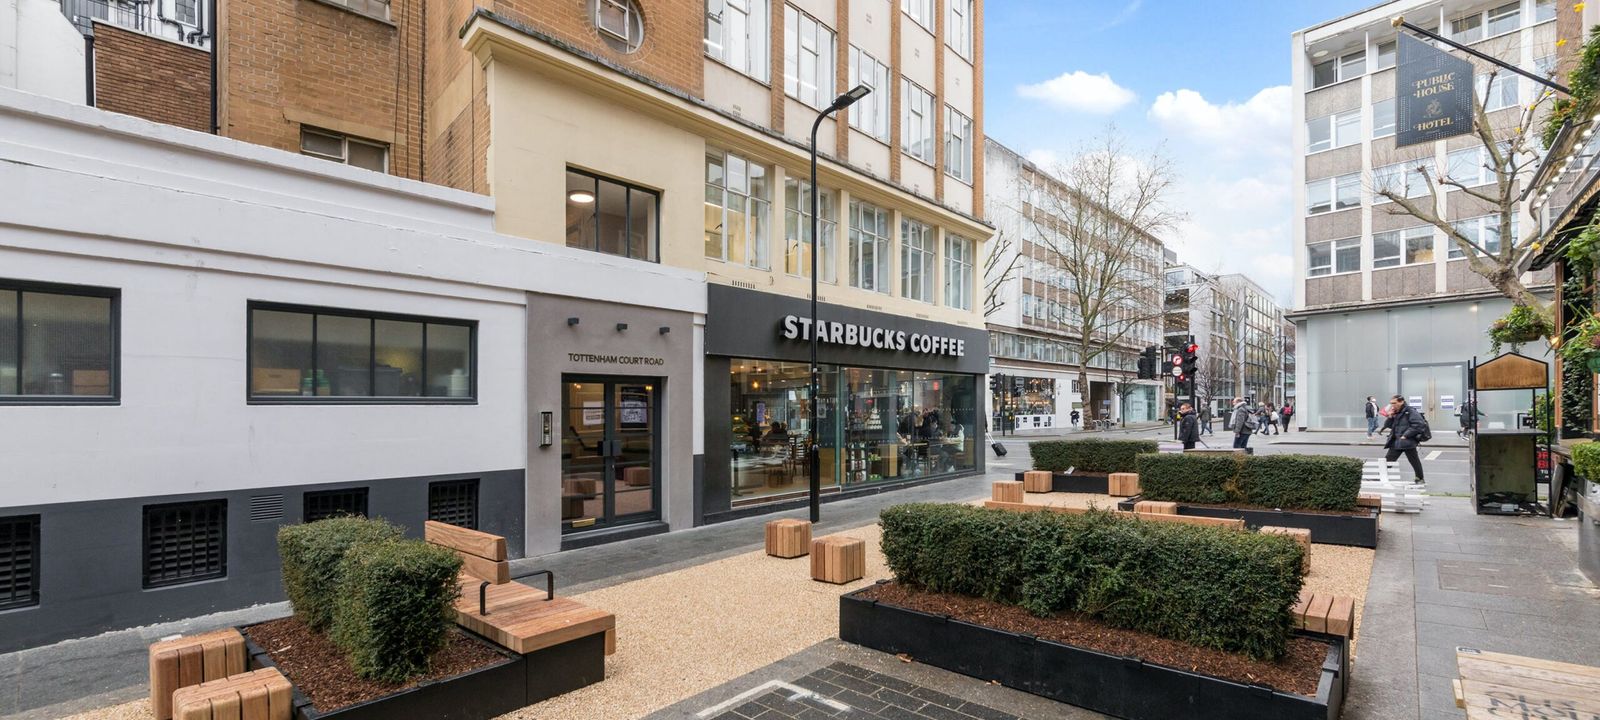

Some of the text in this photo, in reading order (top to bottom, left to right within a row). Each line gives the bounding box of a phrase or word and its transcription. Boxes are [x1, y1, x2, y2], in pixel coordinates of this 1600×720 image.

[1413, 72, 1455, 88] PUBLIC
[1413, 82, 1455, 98] HOUSE
[1413, 117, 1454, 131] HOTEL
[784, 314, 965, 357] STARBUCKS COFFEE
[568, 353, 664, 366] TOTTENHAM COURT ROAD
